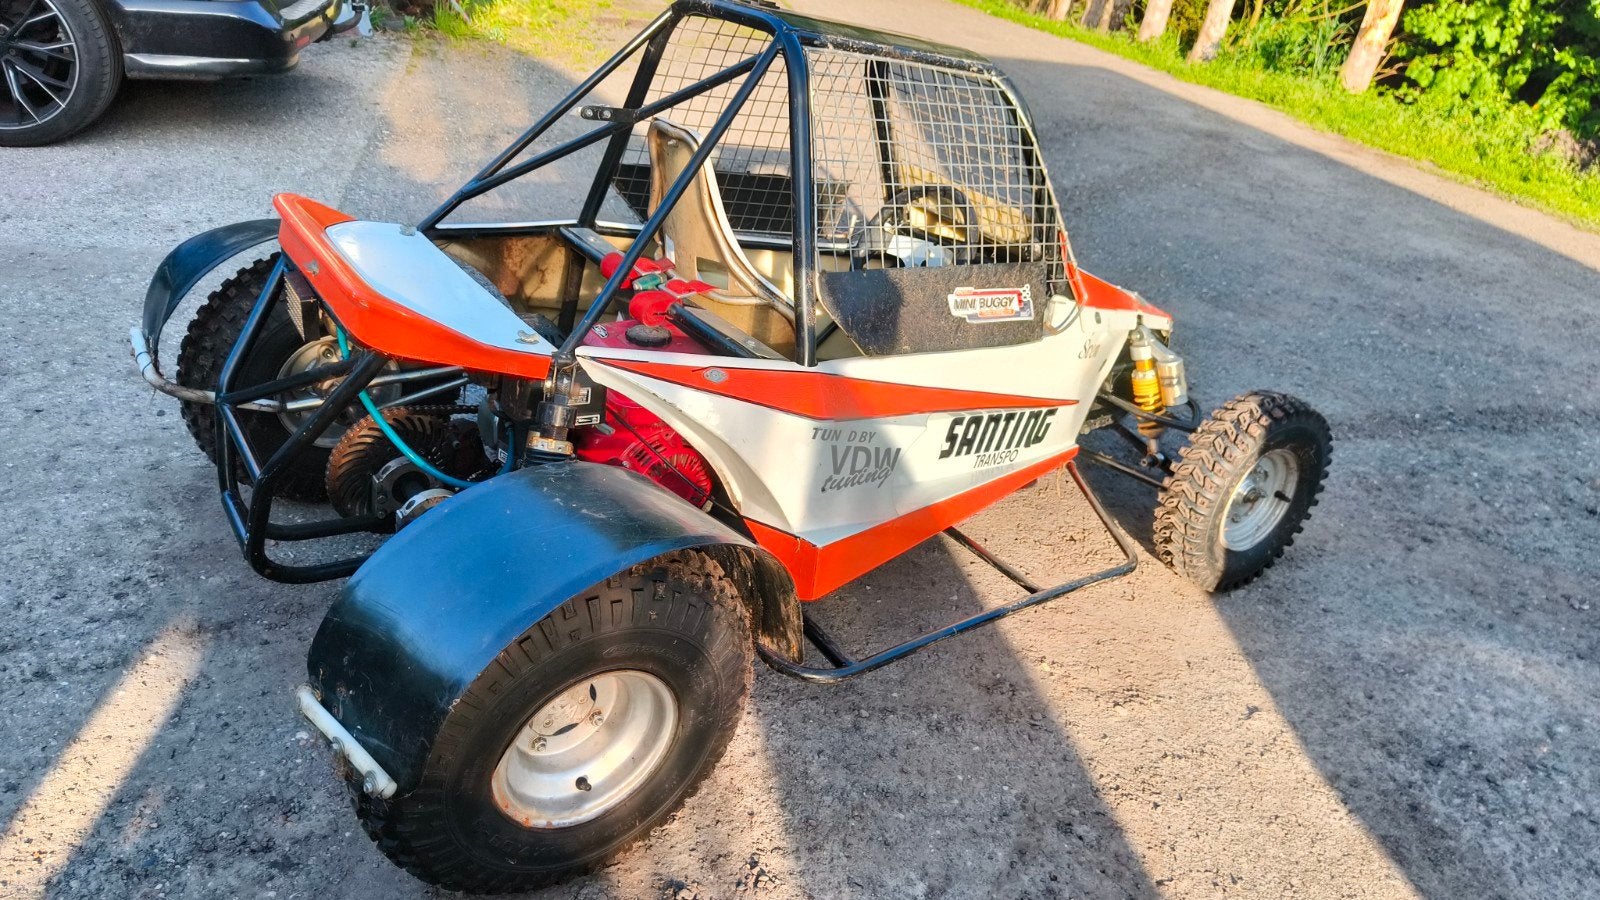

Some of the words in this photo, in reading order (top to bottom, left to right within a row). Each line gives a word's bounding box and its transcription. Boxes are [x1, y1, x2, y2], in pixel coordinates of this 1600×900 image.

[953, 298, 977, 311] MINI
[979, 297, 1014, 308] BUGGY
[938, 407, 1059, 459] SANTING
[831, 444, 902, 475] VDW
[820, 466, 891, 492] tuning
